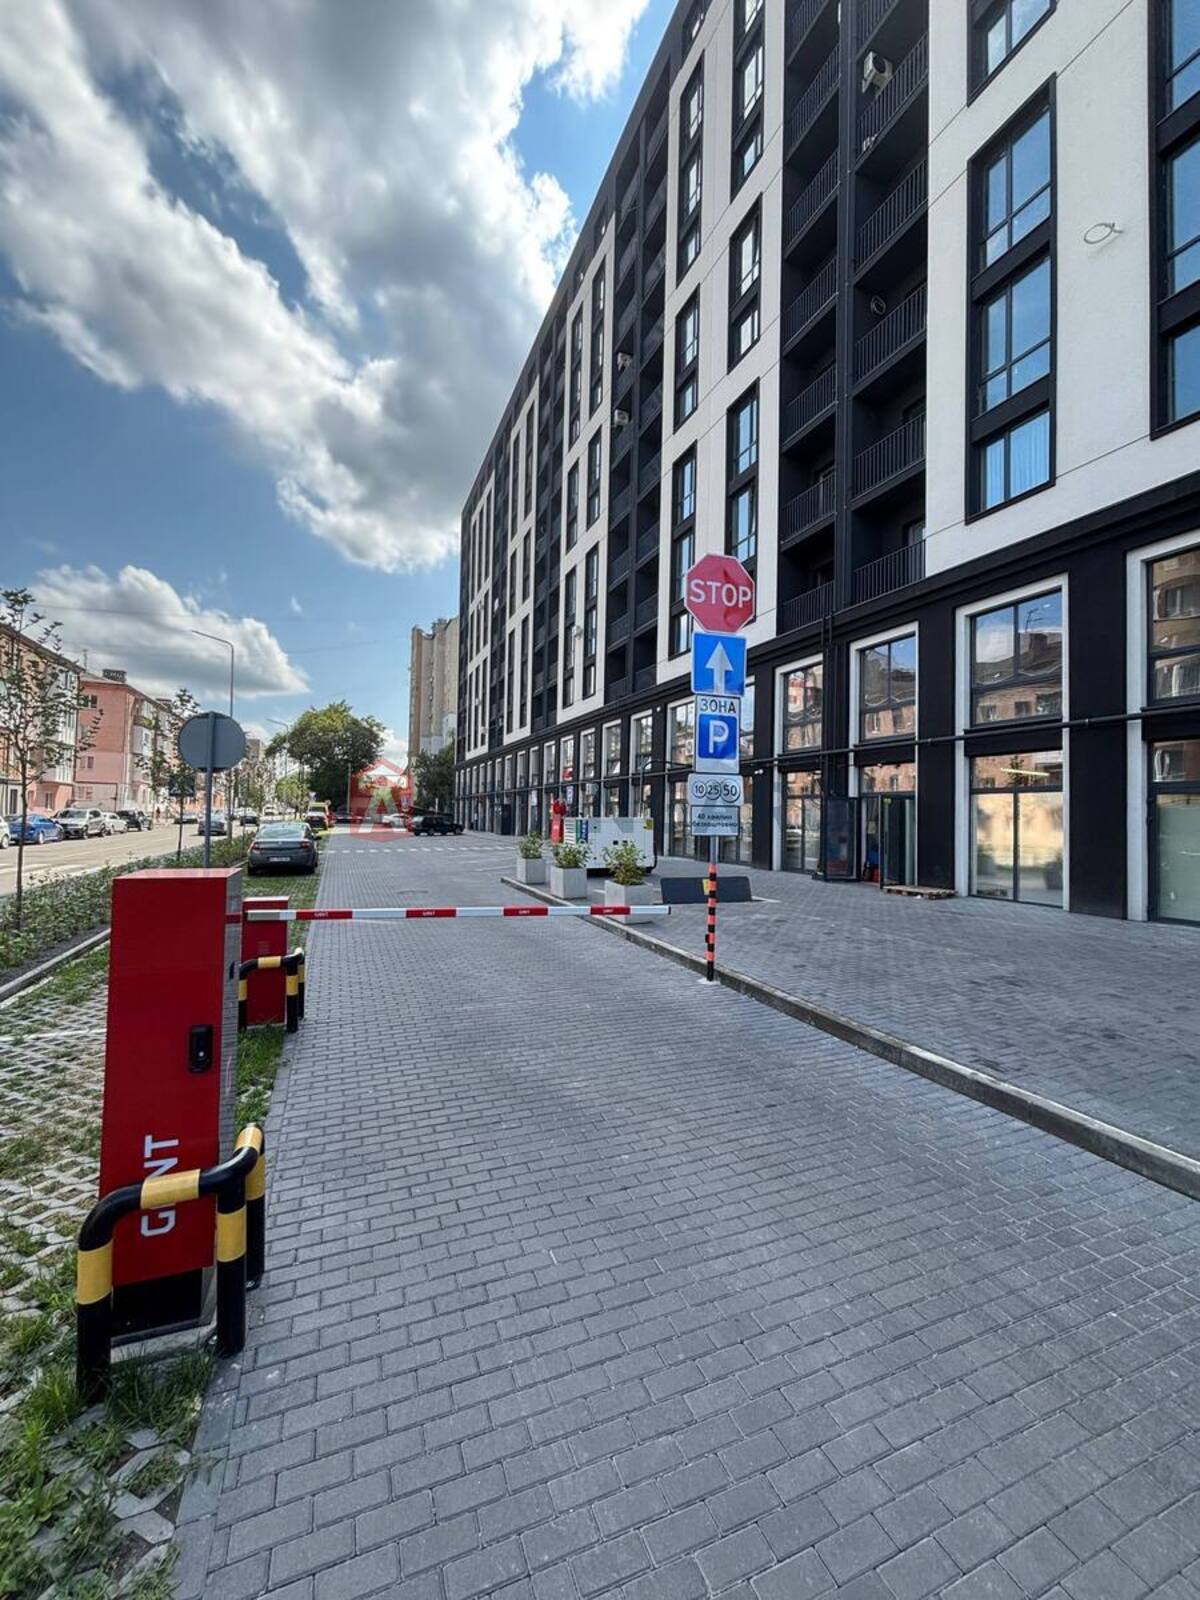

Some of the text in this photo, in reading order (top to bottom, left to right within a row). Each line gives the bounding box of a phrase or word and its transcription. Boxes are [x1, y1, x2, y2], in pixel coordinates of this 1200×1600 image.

[690, 579, 752, 609] STOP
[700, 699, 737, 714] ЗОНА
[708, 719, 730, 754] P
[707, 784, 720, 796] 25
[723, 784, 737, 797] 50
[140, 1135, 179, 1237] GNT
